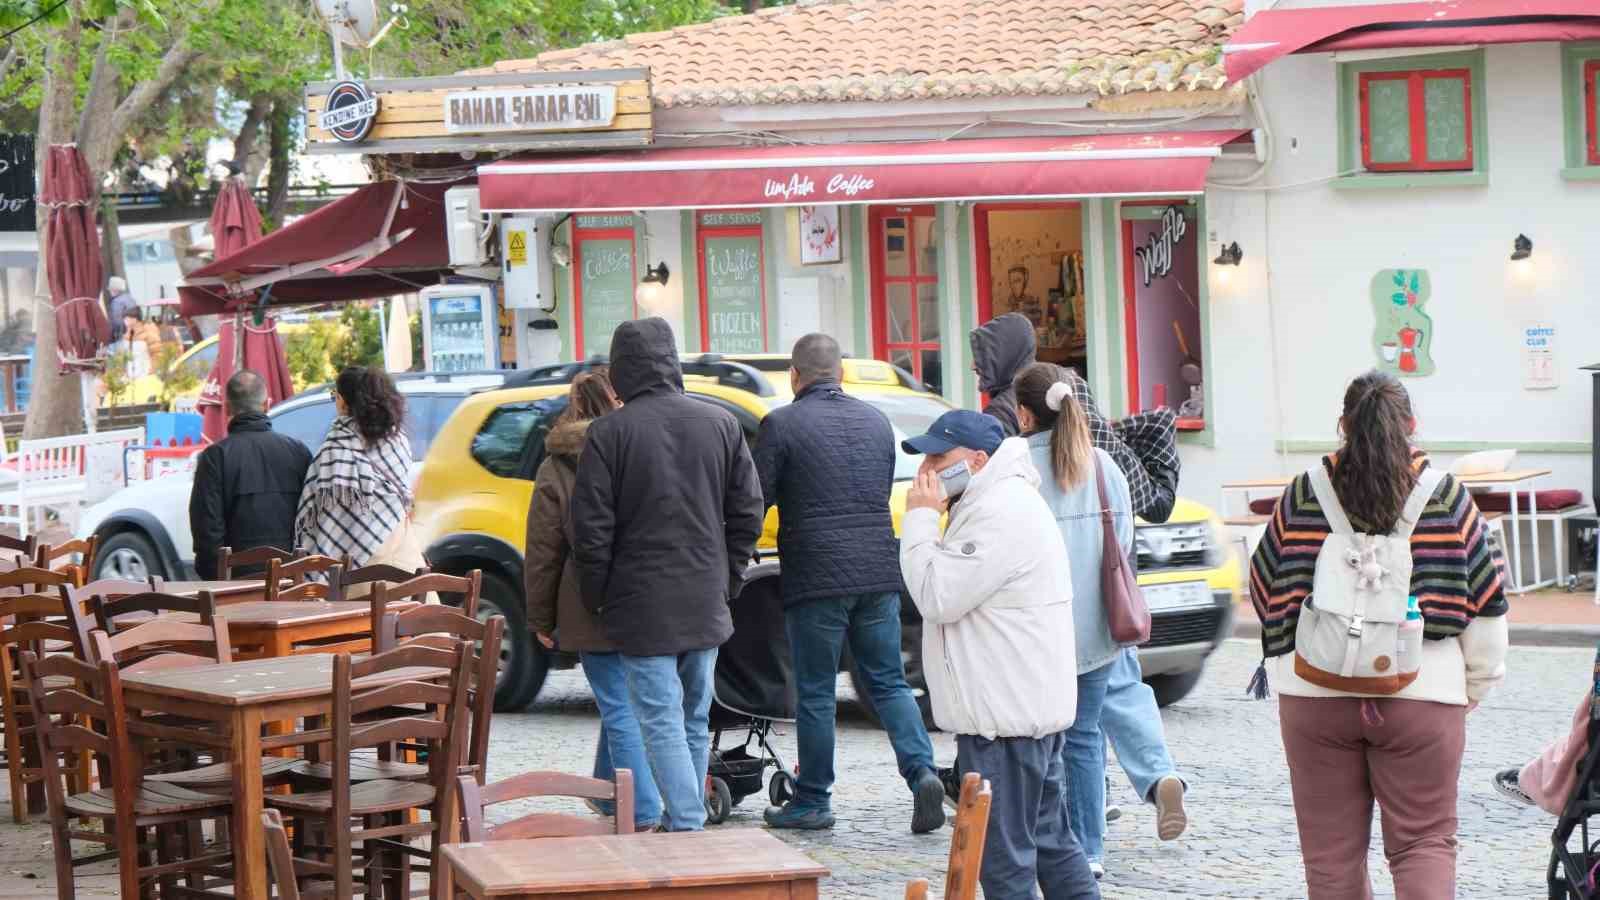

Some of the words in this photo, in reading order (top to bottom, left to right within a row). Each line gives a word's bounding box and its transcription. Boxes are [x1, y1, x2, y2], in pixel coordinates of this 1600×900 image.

[450, 96, 506, 125] BAHAR
[826, 173, 875, 196] Coffee
[1135, 205, 1187, 287] Waffle
[711, 311, 761, 336] FROZEN
